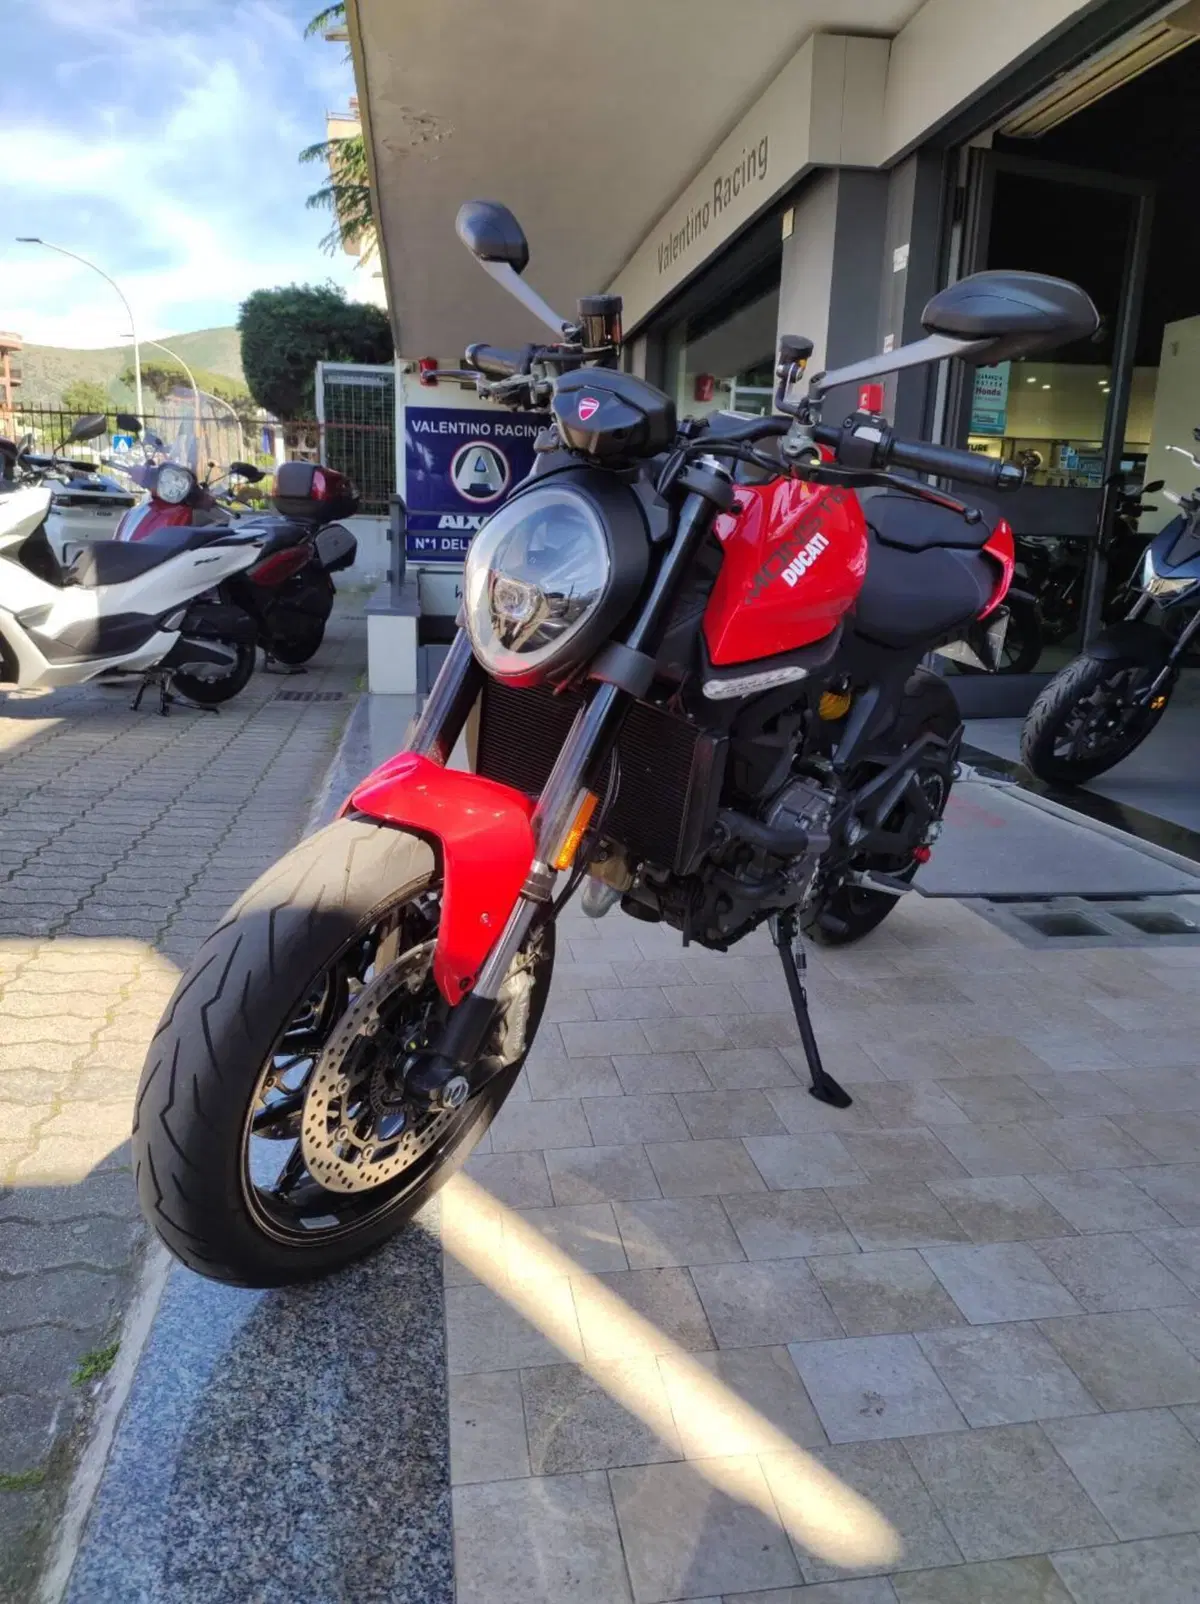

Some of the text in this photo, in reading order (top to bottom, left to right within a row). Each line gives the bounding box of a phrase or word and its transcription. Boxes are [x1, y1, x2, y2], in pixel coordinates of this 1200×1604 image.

[657, 135, 768, 276] Valentino Racing
[411, 419, 491, 436] VALENTINO
[441, 538, 471, 551] DEL
[781, 531, 831, 588] DUCATI
